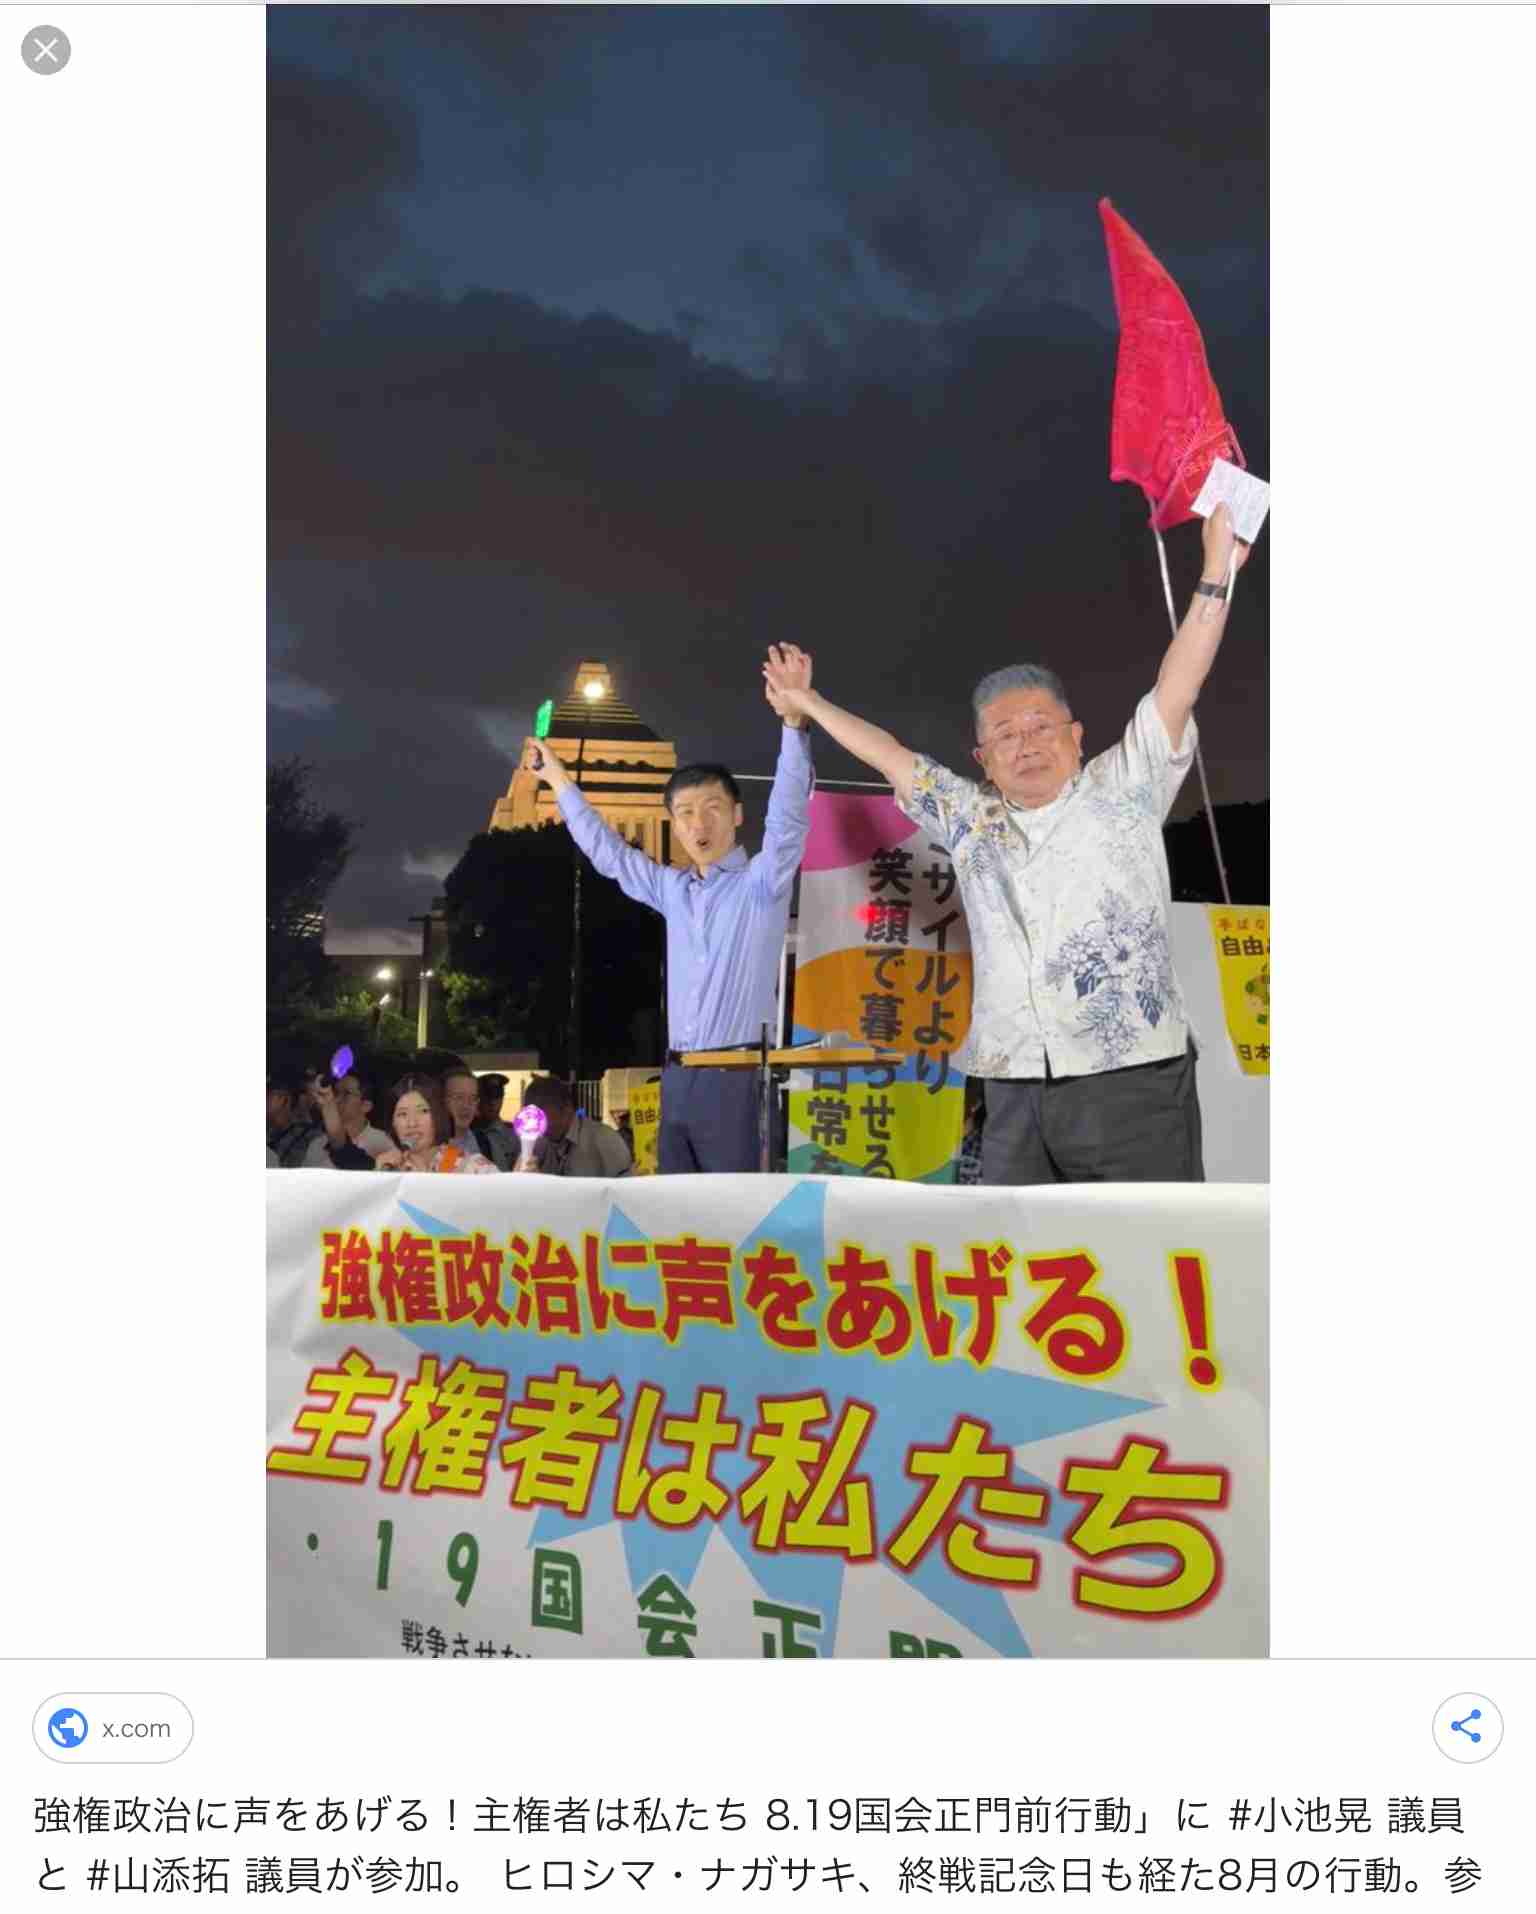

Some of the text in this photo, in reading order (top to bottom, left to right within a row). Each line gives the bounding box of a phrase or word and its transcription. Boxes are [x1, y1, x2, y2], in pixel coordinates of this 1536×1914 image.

[914, 842, 960, 1096] サイルより
[1221, 935, 1270, 956] 自由
[320, 1230, 1221, 1390] 強権政治に声をあげる！
[266, 1350, 1230, 1622] 主権者は私たち
